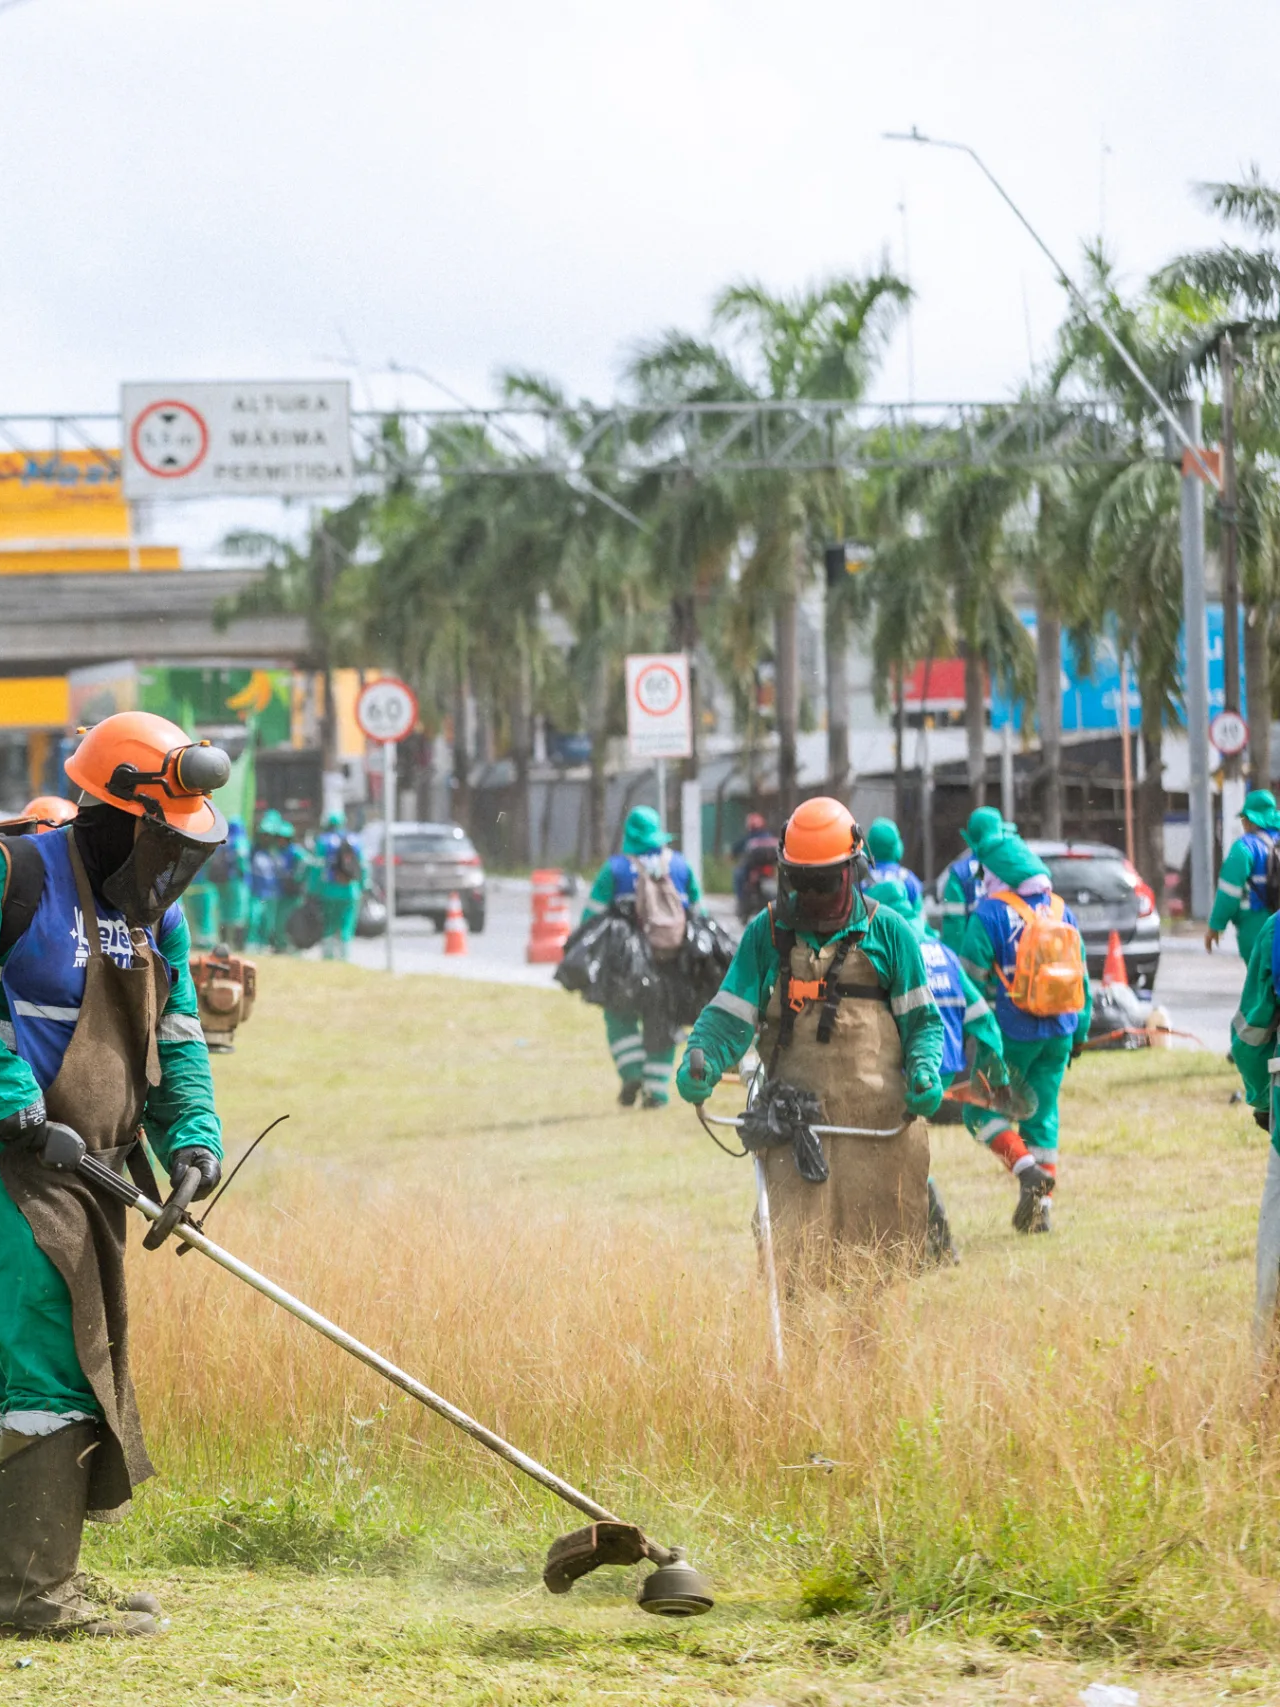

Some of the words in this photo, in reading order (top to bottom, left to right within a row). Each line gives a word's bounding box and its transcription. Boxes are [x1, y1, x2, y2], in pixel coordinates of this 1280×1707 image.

[231, 394, 330, 413] ALTURA
[213, 461, 345, 481] PERMITIDA
[367, 697, 403, 721] 60
